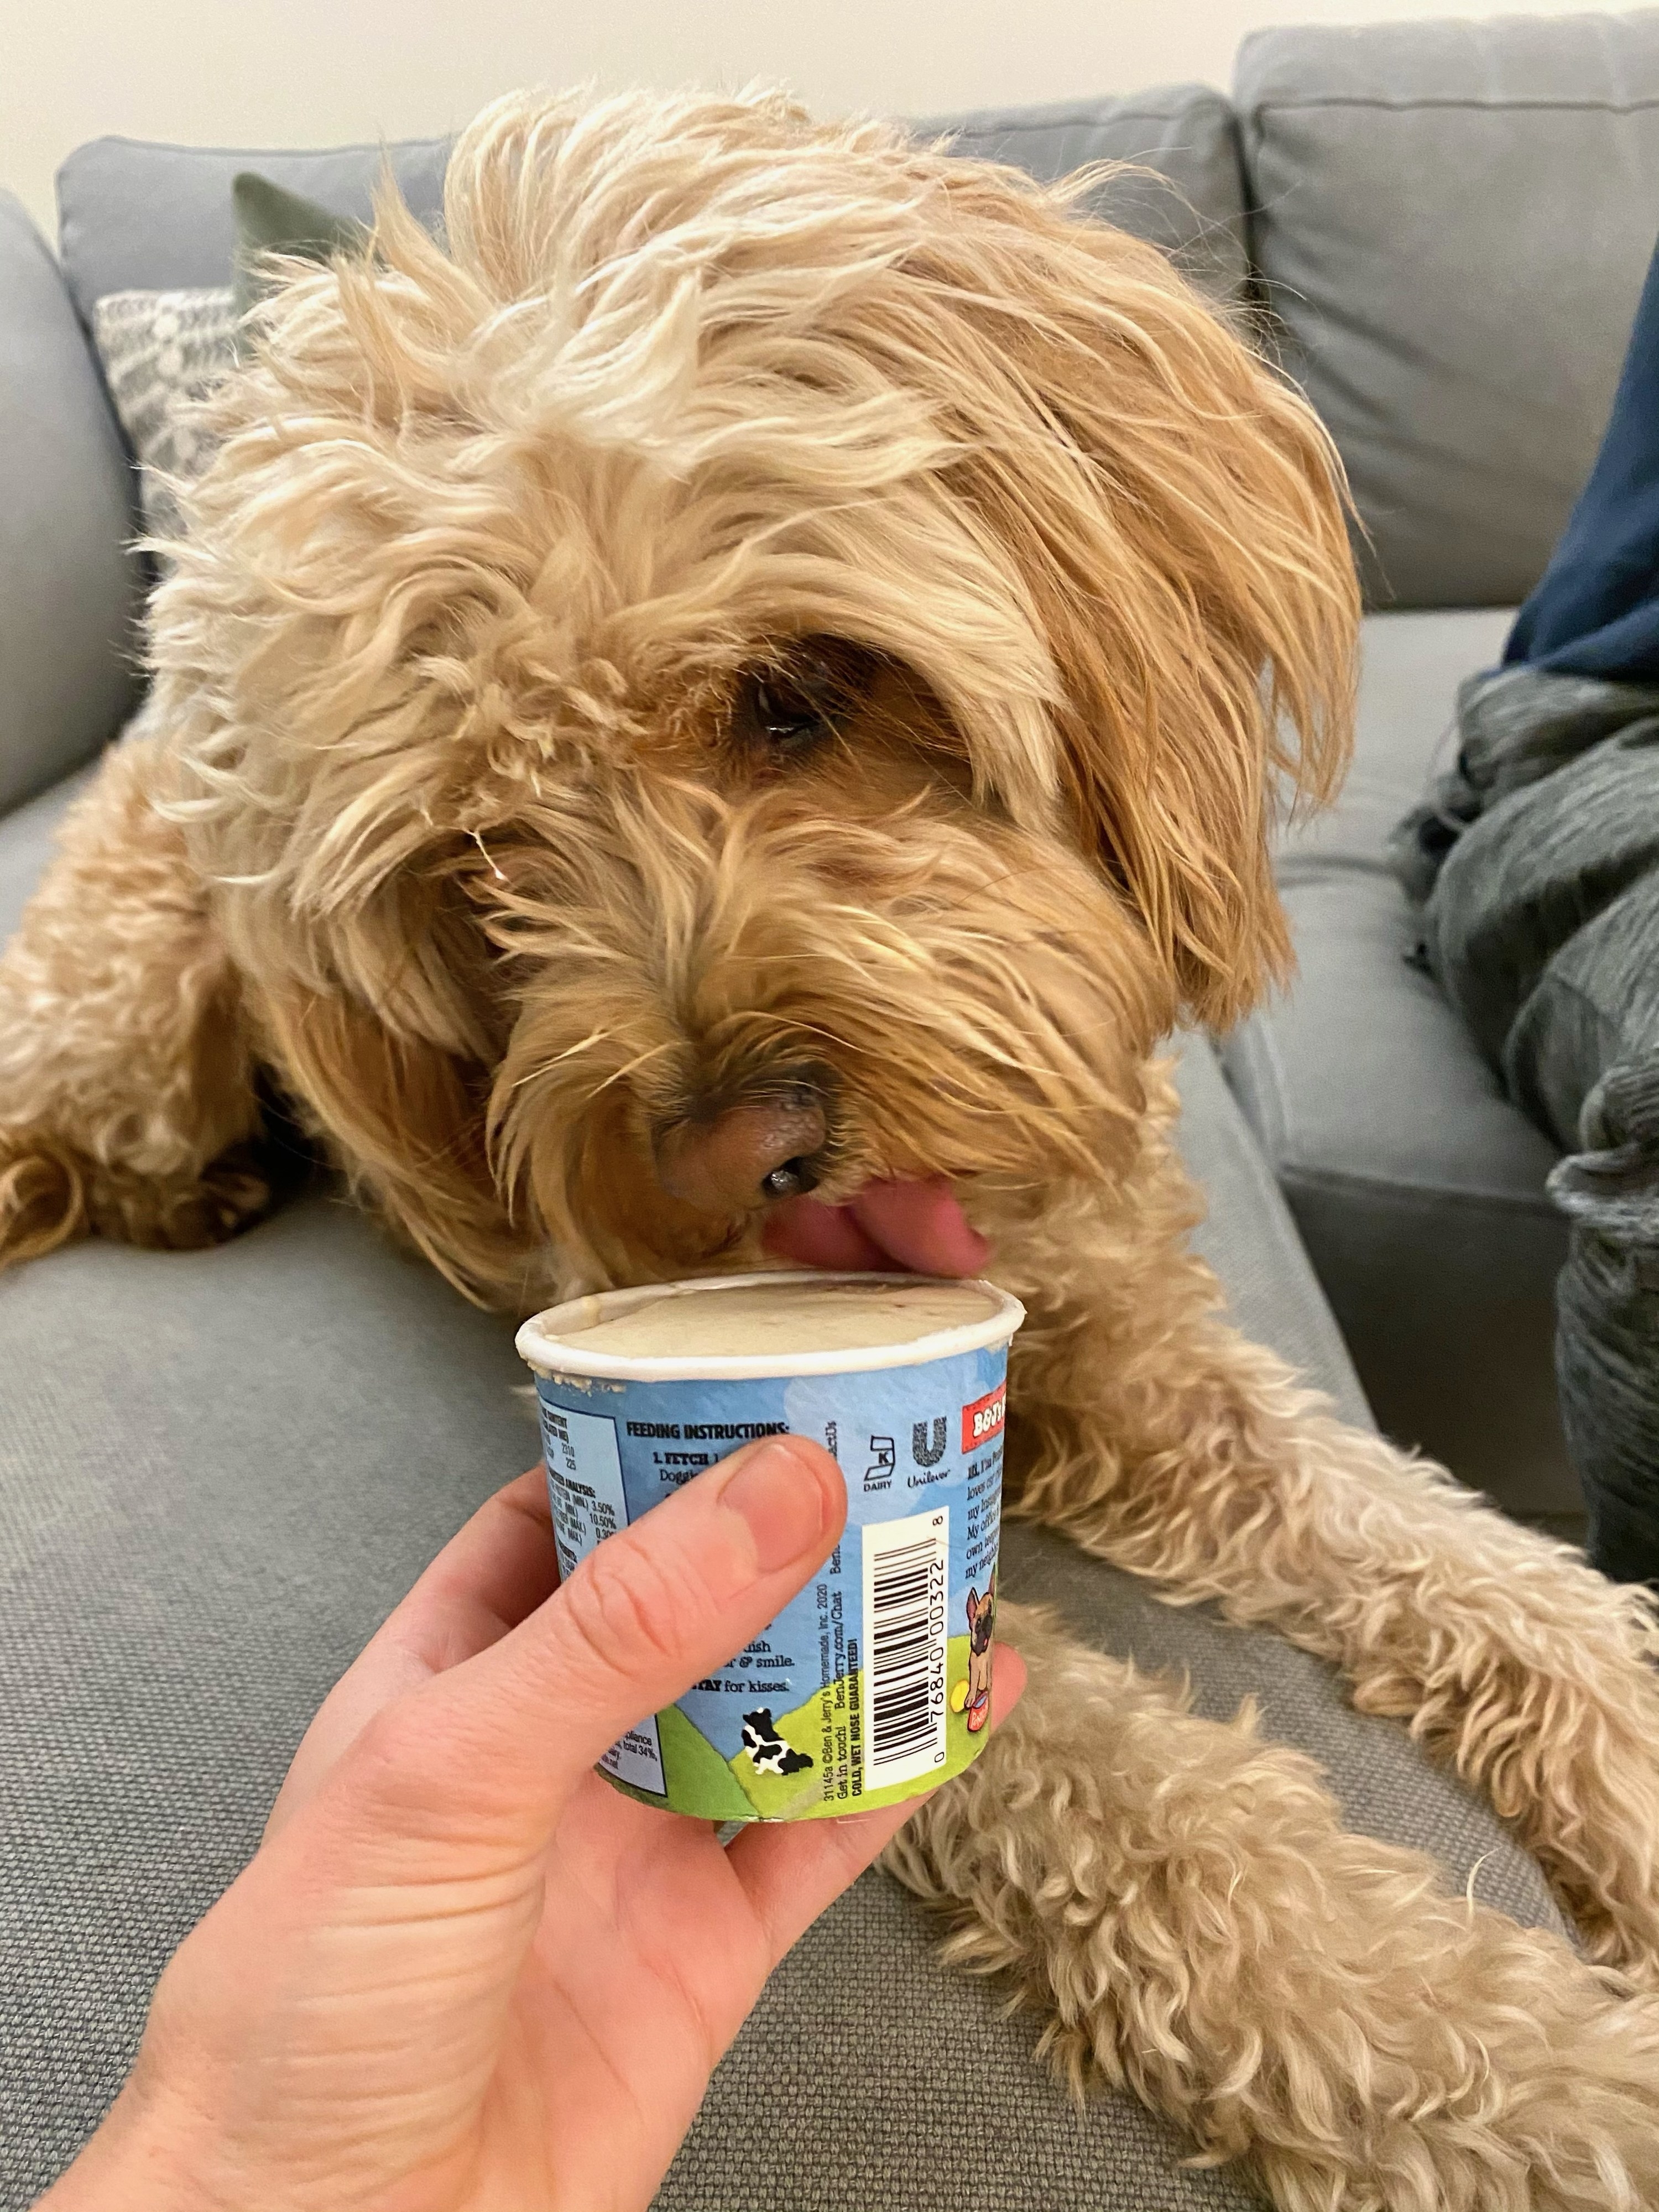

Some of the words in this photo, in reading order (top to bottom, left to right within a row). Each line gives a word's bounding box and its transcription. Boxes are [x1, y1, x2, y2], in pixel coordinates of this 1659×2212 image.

[627, 1421, 681, 1439] FEEDING
[684, 1422, 790, 1439] INSTRUCTIONS:
[825, 1420, 837, 1461] actUs
[664, 1452, 708, 1465] FETCH
[863, 1480, 892, 1492] DAIRY
[907, 1469, 951, 1489] Unilever
[591, 1501, 615, 1516] 3.50%
[968, 1505, 979, 1521] my
[589, 1513, 617, 1530] 10.50%
[932, 1515, 943, 1526] 8
[967, 1524, 979, 1540] My
[830, 1545, 841, 1575] Ben
[966, 1542, 983, 1560] own
[965, 1562, 978, 1579] my
[816, 1583, 828, 1610] 2020
[930, 1560, 944, 1637] 00322
[831, 1590, 846, 1710] BenJerry.com/Chat
[757, 1655, 795, 1668] smile.
[819, 1632, 831, 1689] Homemade,
[847, 1638, 860, 1711] GUARANTEED!
[692, 1679, 722, 1692] TAY
[724, 1679, 745, 1693] for
[749, 1680, 790, 1693] kisses.
[930, 1647, 944, 1724] 76840
[821, 1690, 833, 1723] Jerry's
[849, 1713, 860, 1741] NOSE
[623, 1740, 637, 1754] total
[851, 1745, 862, 1766] WET
[933, 1751, 945, 1763] 0
[837, 1764, 848, 1777] in
[823, 1766, 834, 1802] 31145a
[837, 1778, 848, 1799] Get
[852, 1767, 863, 1797] COLD,
